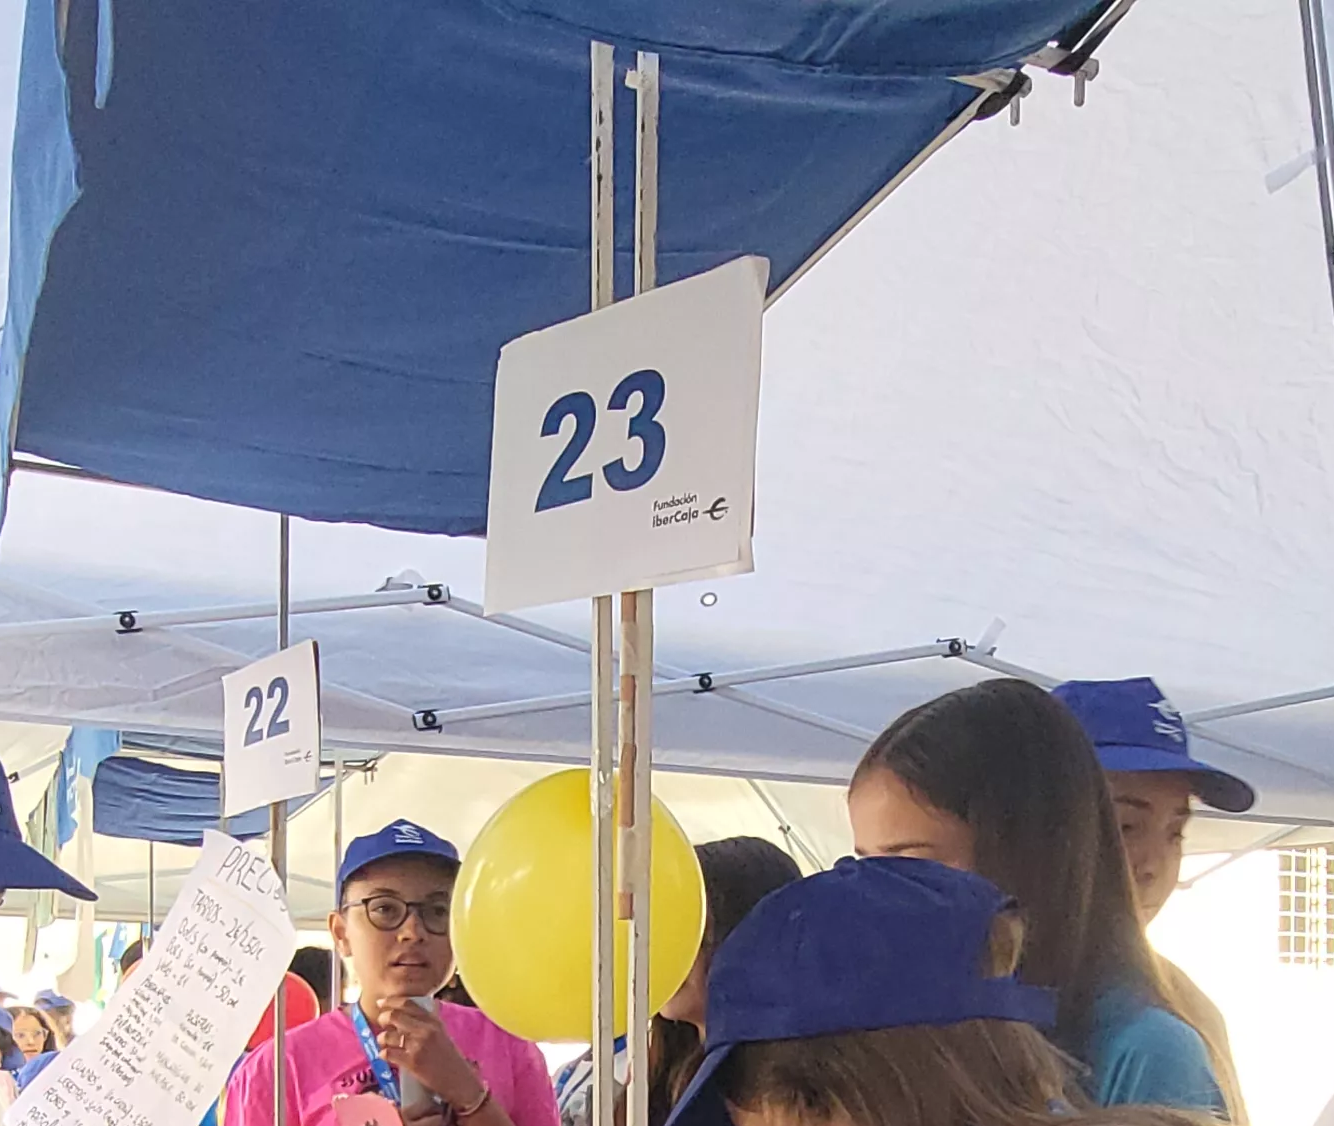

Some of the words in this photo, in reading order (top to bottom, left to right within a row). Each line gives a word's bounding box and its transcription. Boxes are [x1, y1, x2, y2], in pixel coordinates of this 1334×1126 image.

[534, 369, 666, 513] 23
[653, 493, 697, 512] Fundación
[244, 676, 290, 747] 22
